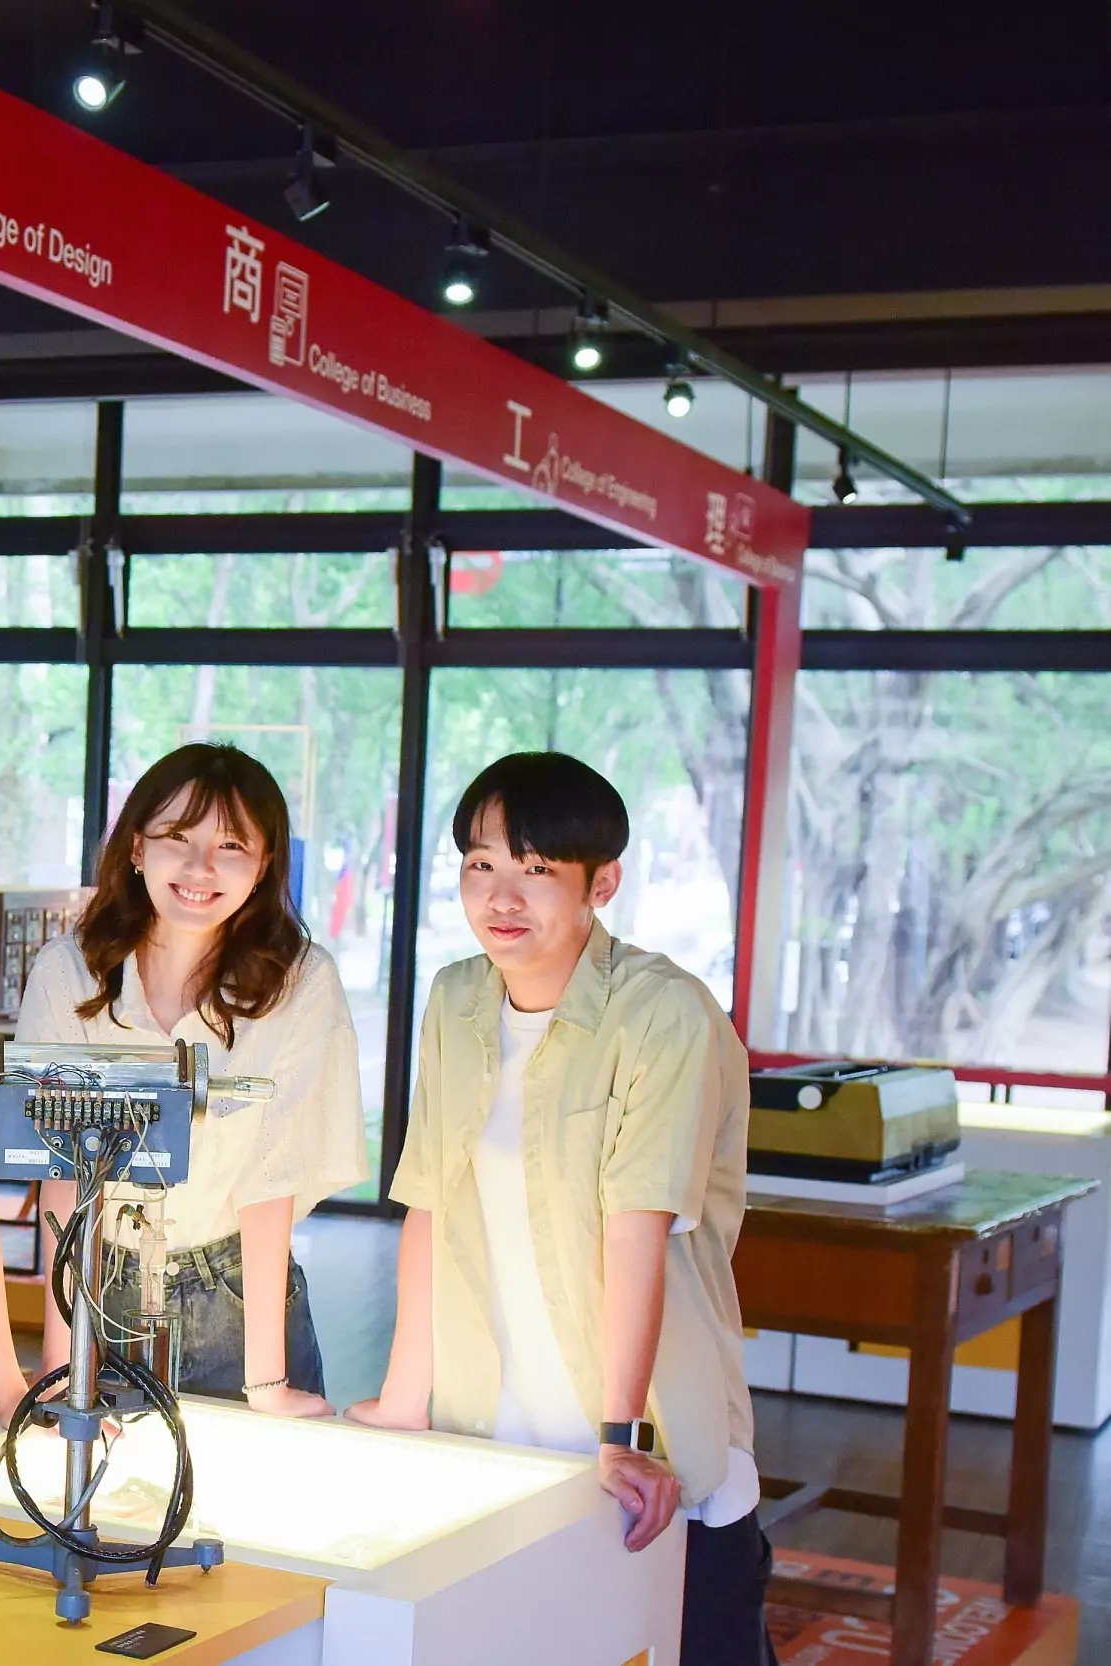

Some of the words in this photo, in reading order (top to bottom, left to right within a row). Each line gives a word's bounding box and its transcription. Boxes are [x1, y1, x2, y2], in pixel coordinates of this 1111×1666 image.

[23, 222, 45, 257] of
[48, 227, 113, 288] Design
[223, 224, 266, 324] 商
[308, 343, 360, 394] College
[360, 369, 377, 397] of
[376, 373, 432, 422] Business
[502, 399, 533, 473] 工
